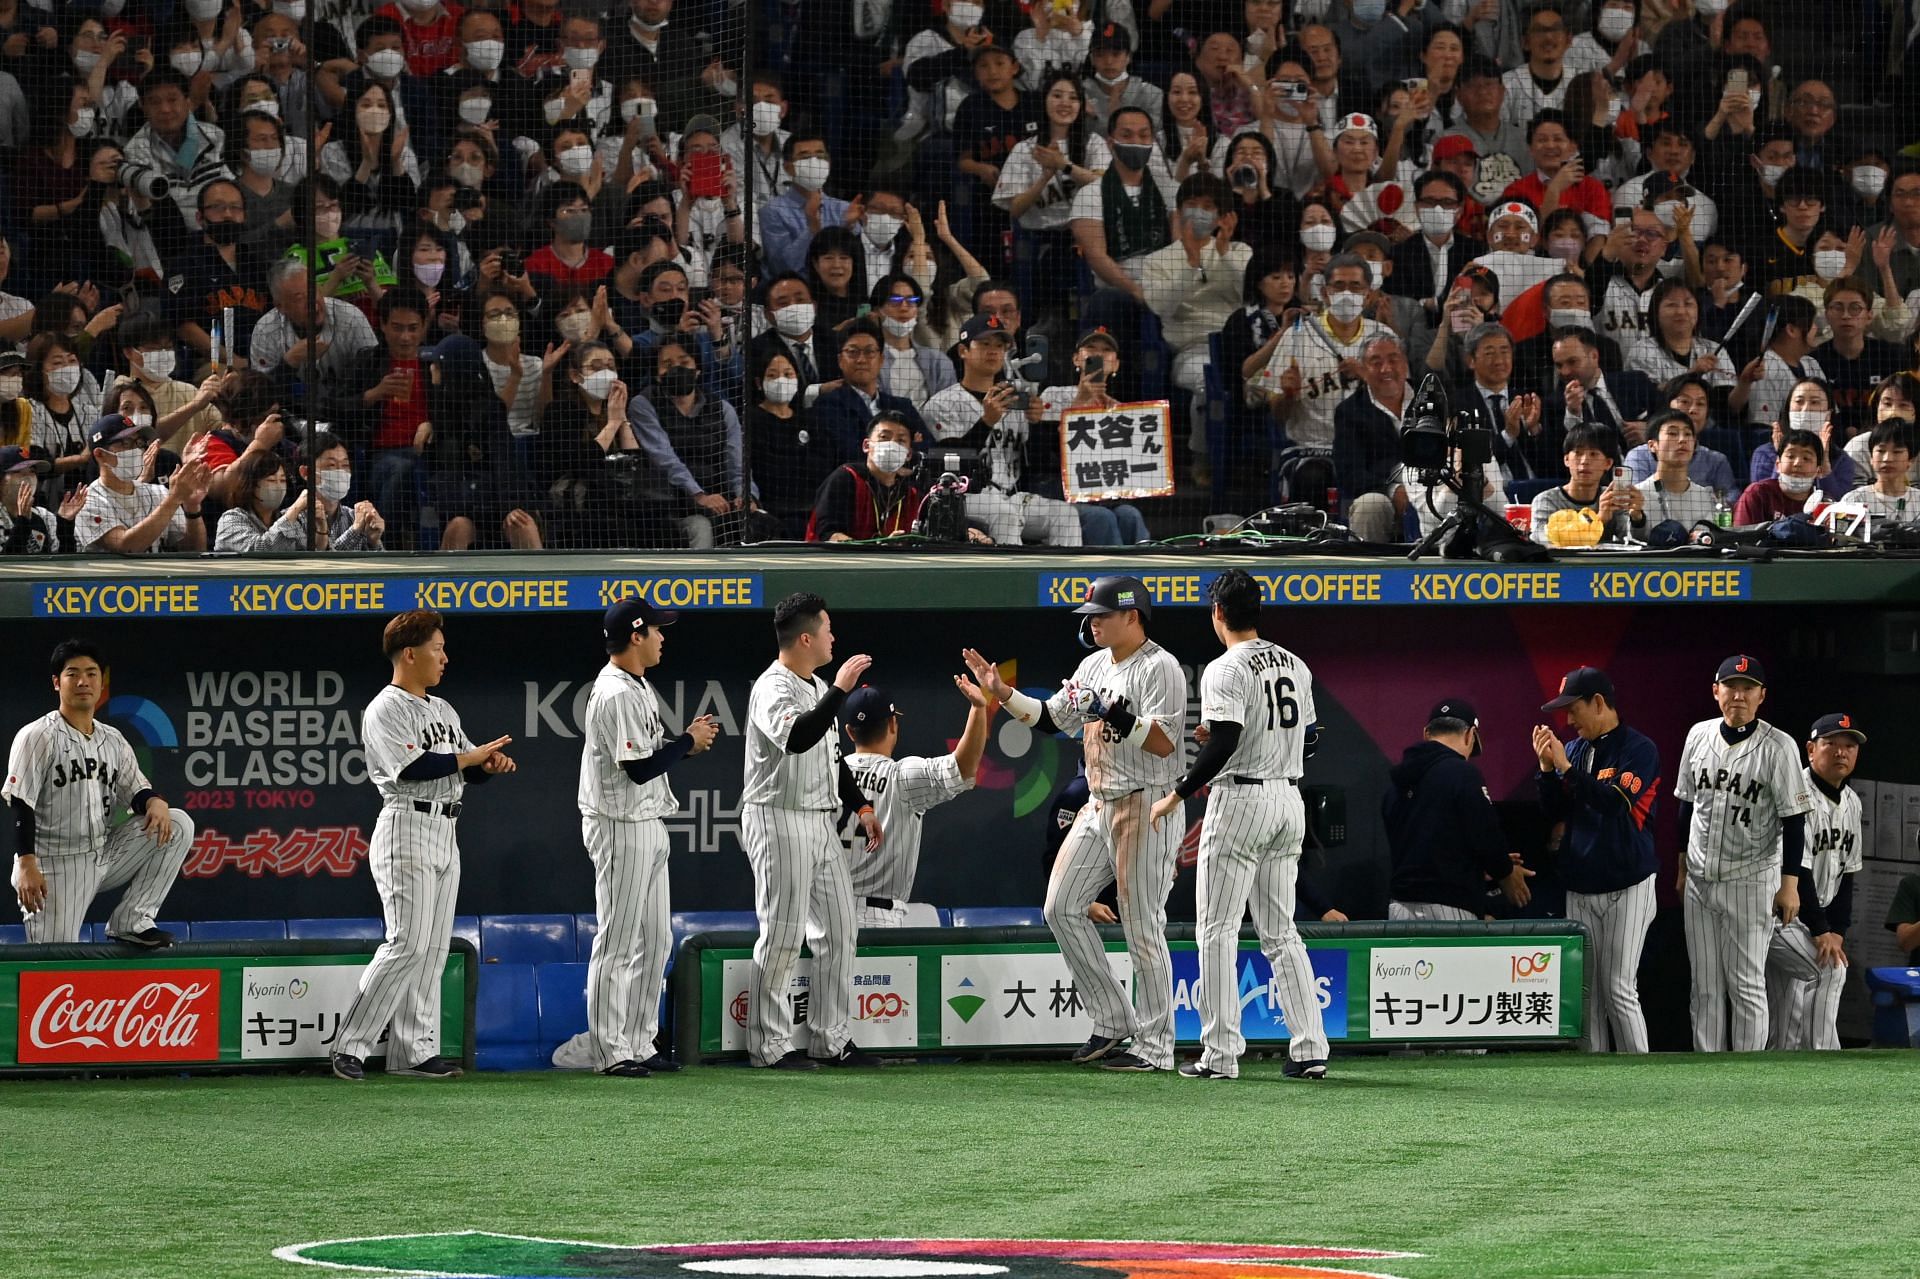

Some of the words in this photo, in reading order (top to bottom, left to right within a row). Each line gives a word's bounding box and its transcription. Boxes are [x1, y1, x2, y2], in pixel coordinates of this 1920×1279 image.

[1074, 459, 1159, 489] 世界一
[1736, 657, 1749, 673] J
[186, 670, 345, 707] WORLD
[1264, 676, 1299, 731] 16
[187, 710, 363, 747] BASEBA
[184, 748, 369, 787] CLASSIC
[1620, 770, 1643, 795] 89
[185, 791, 236, 810] 2023
[246, 790, 315, 809] TOKYO
[1730, 805, 1752, 829] 74
[183, 826, 369, 878] カーネクスト
[1375, 962, 1412, 980] Kyorin
[1511, 951, 1551, 984] 100
[247, 981, 286, 1000] Kyorin
[30, 981, 212, 1050] Coca-Cola
[1374, 991, 1555, 1027] キョーリン製薬
